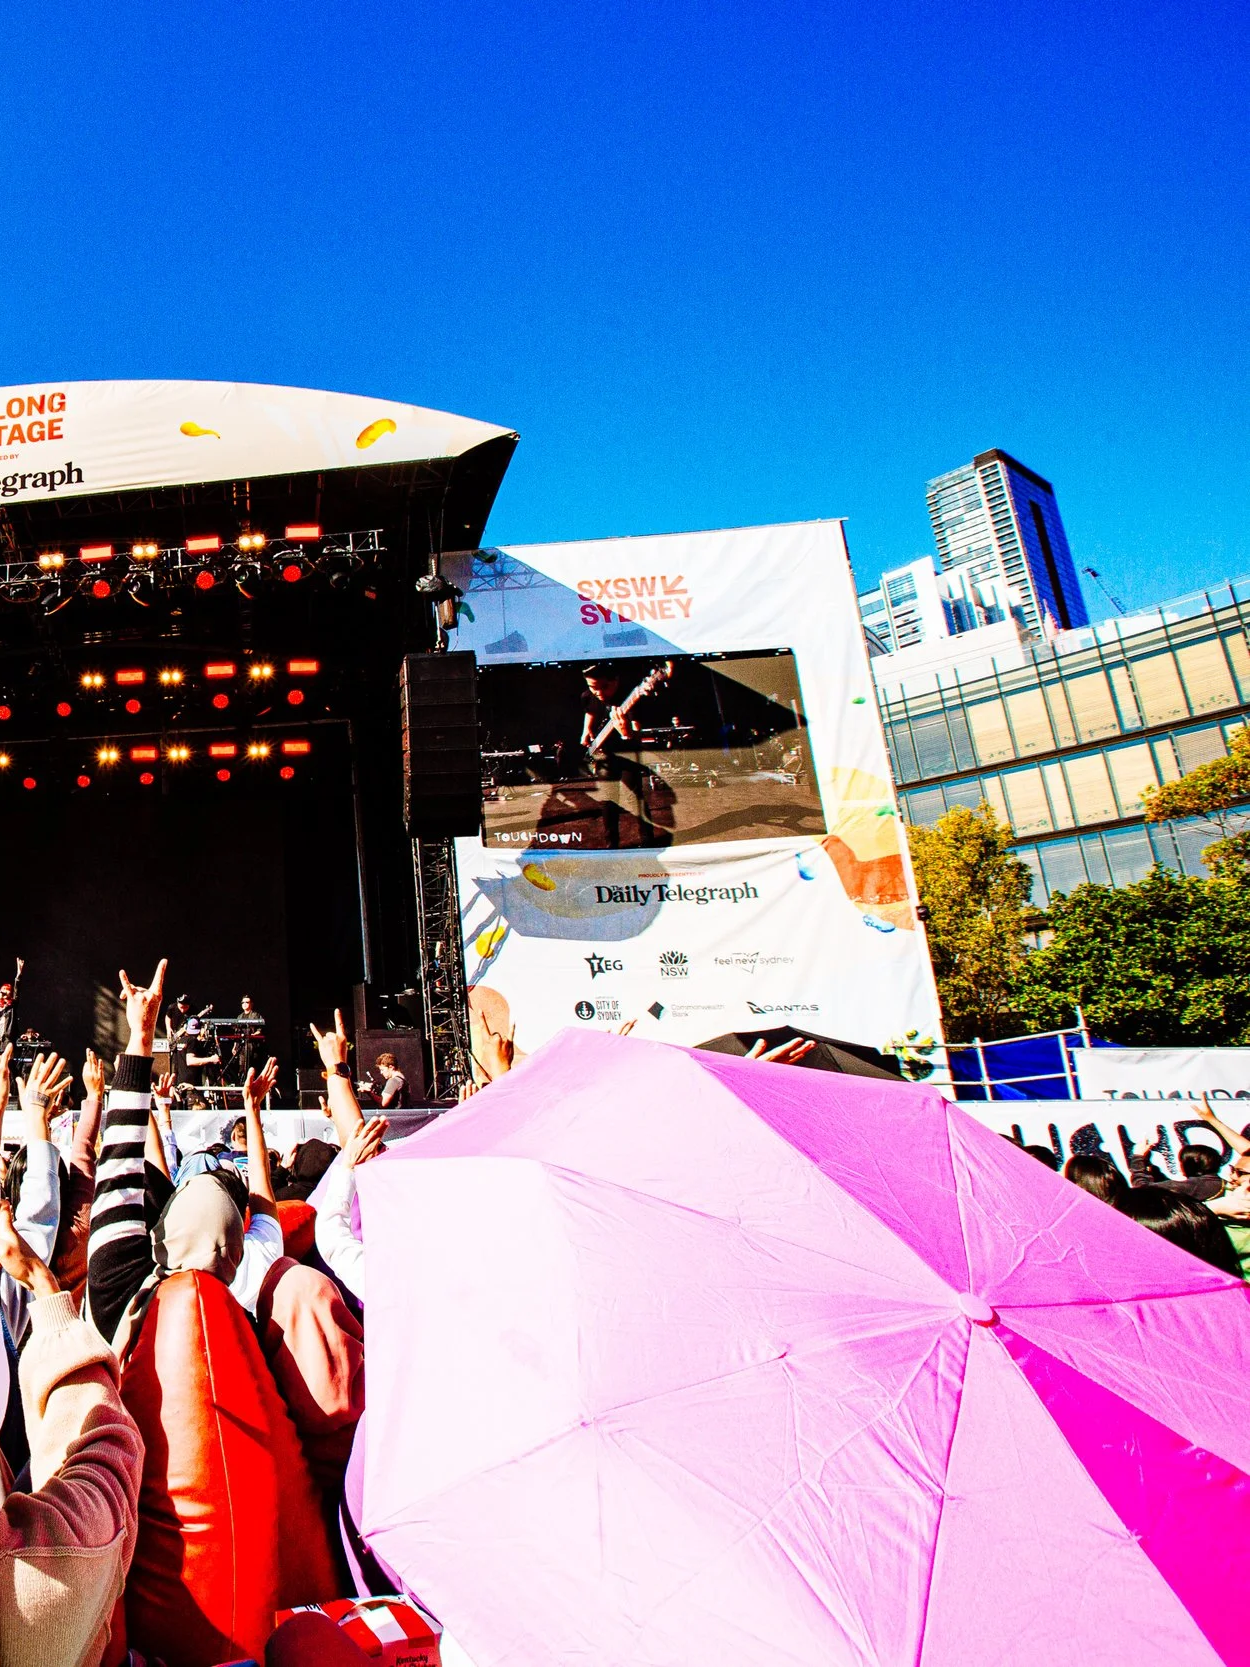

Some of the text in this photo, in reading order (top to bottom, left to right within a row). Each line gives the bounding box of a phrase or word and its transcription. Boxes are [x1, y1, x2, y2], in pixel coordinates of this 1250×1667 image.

[577, 576, 656, 602] SXSW
[580, 597, 694, 625] SYDNEY
[493, 831, 582, 844] TOUCHDOWN
[594, 881, 759, 906] Daily Telegraph
[714, 957, 733, 965] feel
[759, 956, 795, 965] sydney
[660, 967, 689, 976] NSW
[595, 1000, 619, 1010] CITY OF
[763, 1004, 820, 1012] QANTAS
[597, 1011, 622, 1020] SYDNEY
[396, 1654, 429, 1666] Kentucky
